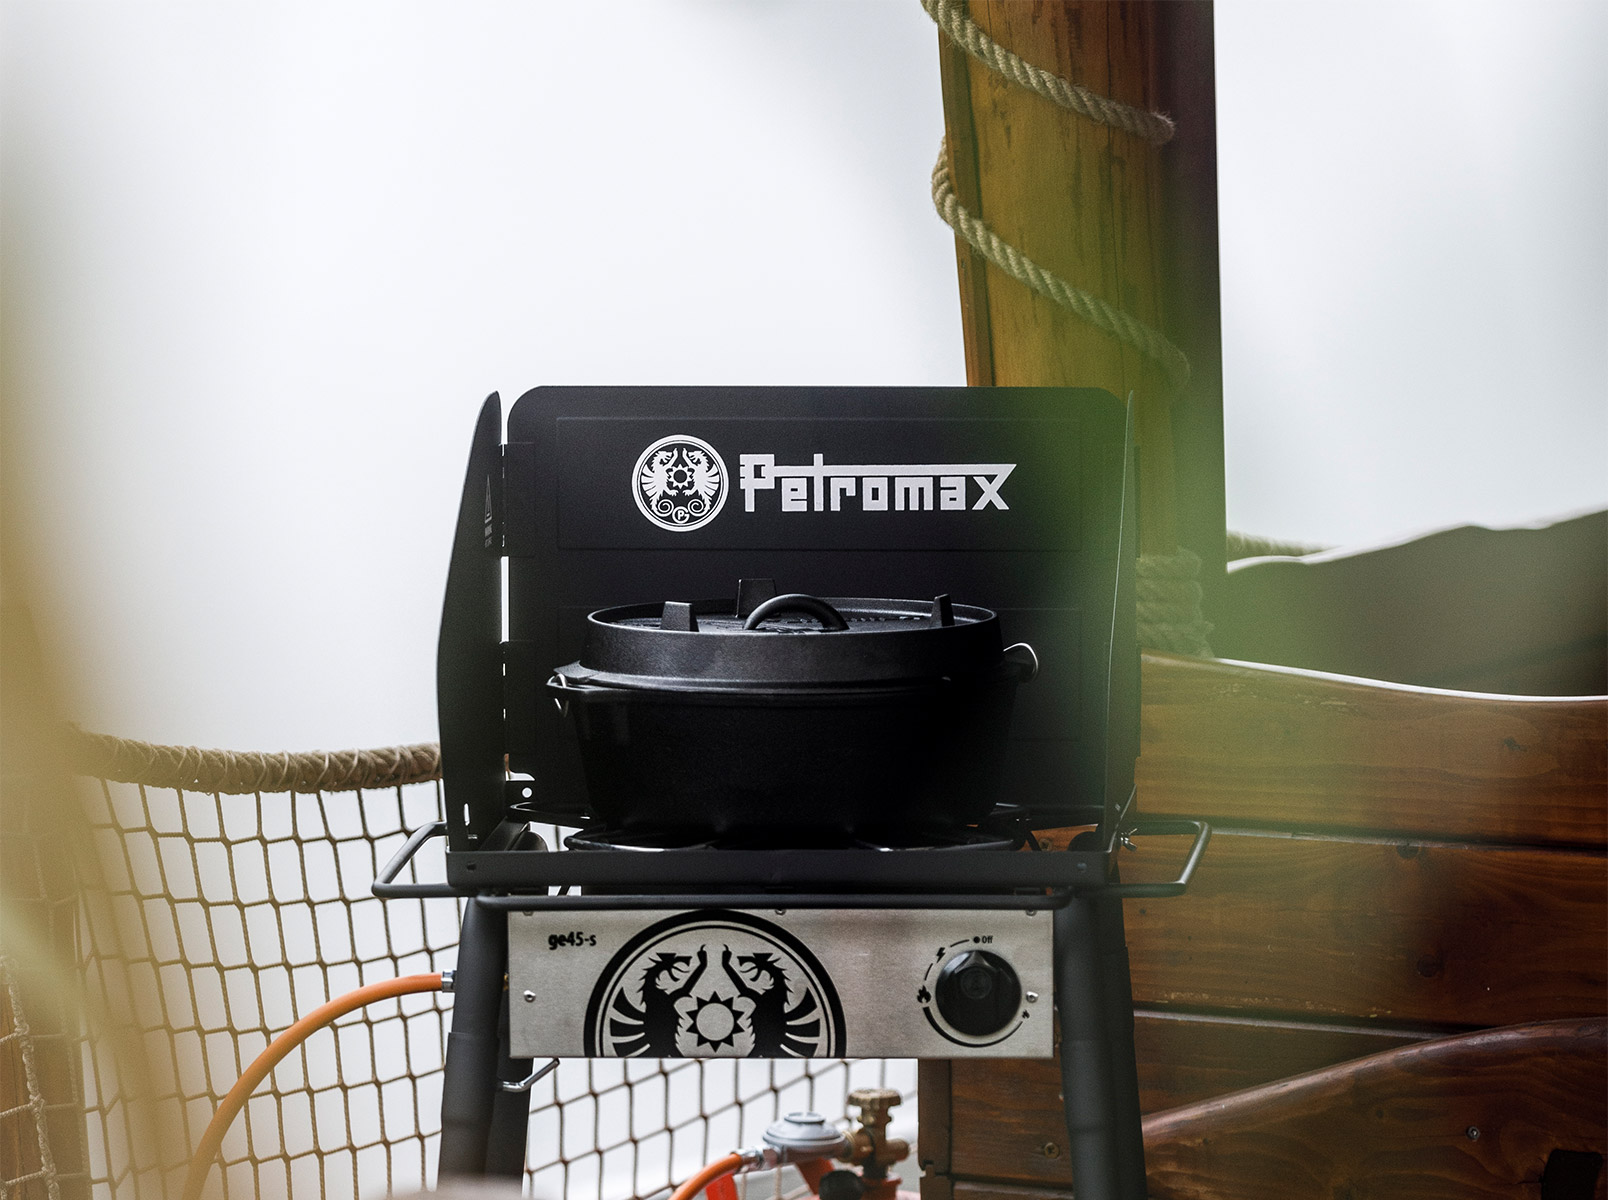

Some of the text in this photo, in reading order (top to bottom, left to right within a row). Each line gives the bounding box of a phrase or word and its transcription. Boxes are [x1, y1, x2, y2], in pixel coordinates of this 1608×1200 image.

[739, 453, 1017, 512] Petromax
[548, 931, 597, 950] ge45-s
[982, 935, 993, 944] Off
